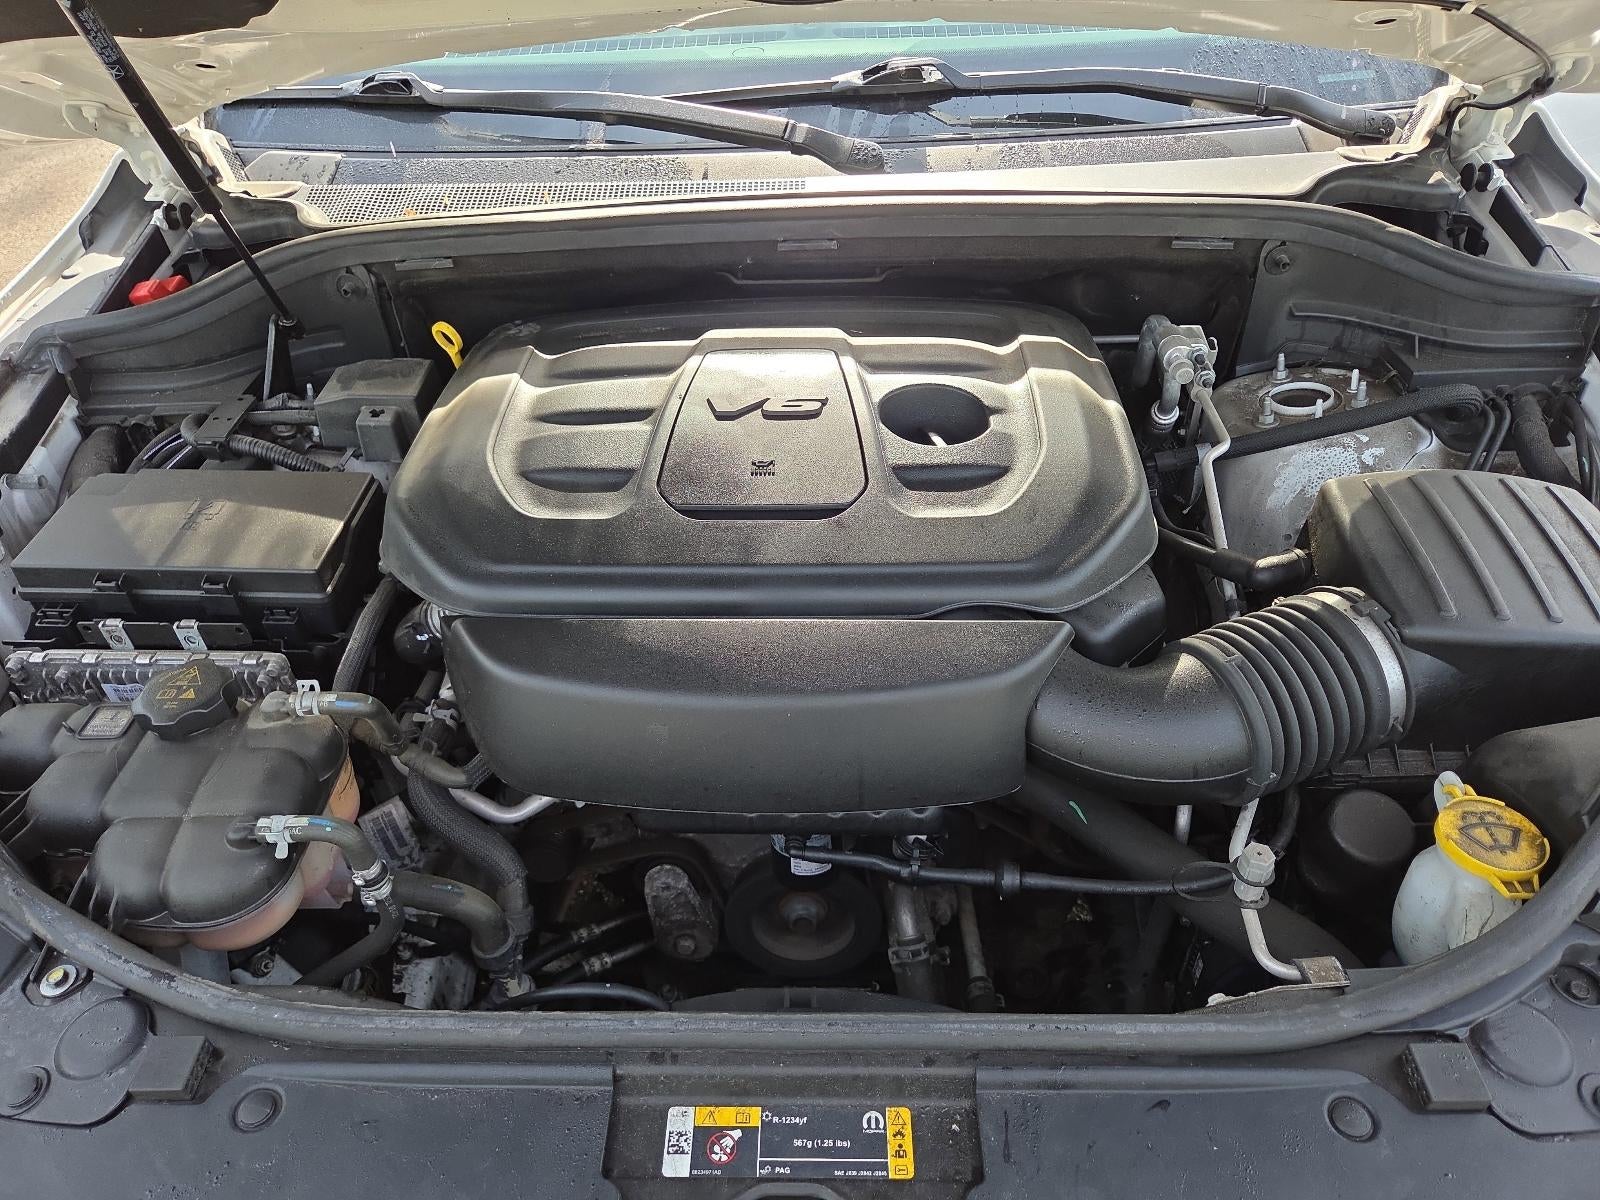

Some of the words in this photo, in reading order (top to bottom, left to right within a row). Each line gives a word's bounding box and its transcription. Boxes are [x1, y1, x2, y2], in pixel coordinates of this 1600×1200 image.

[706, 397, 829, 421] V6
[772, 1116, 808, 1126] R-1234yf
[793, 1139, 812, 1149] 567g
[814, 1139, 834, 1149] (1.25
[835, 1139, 851, 1149] lbs)
[775, 1166, 791, 1174] PAG
